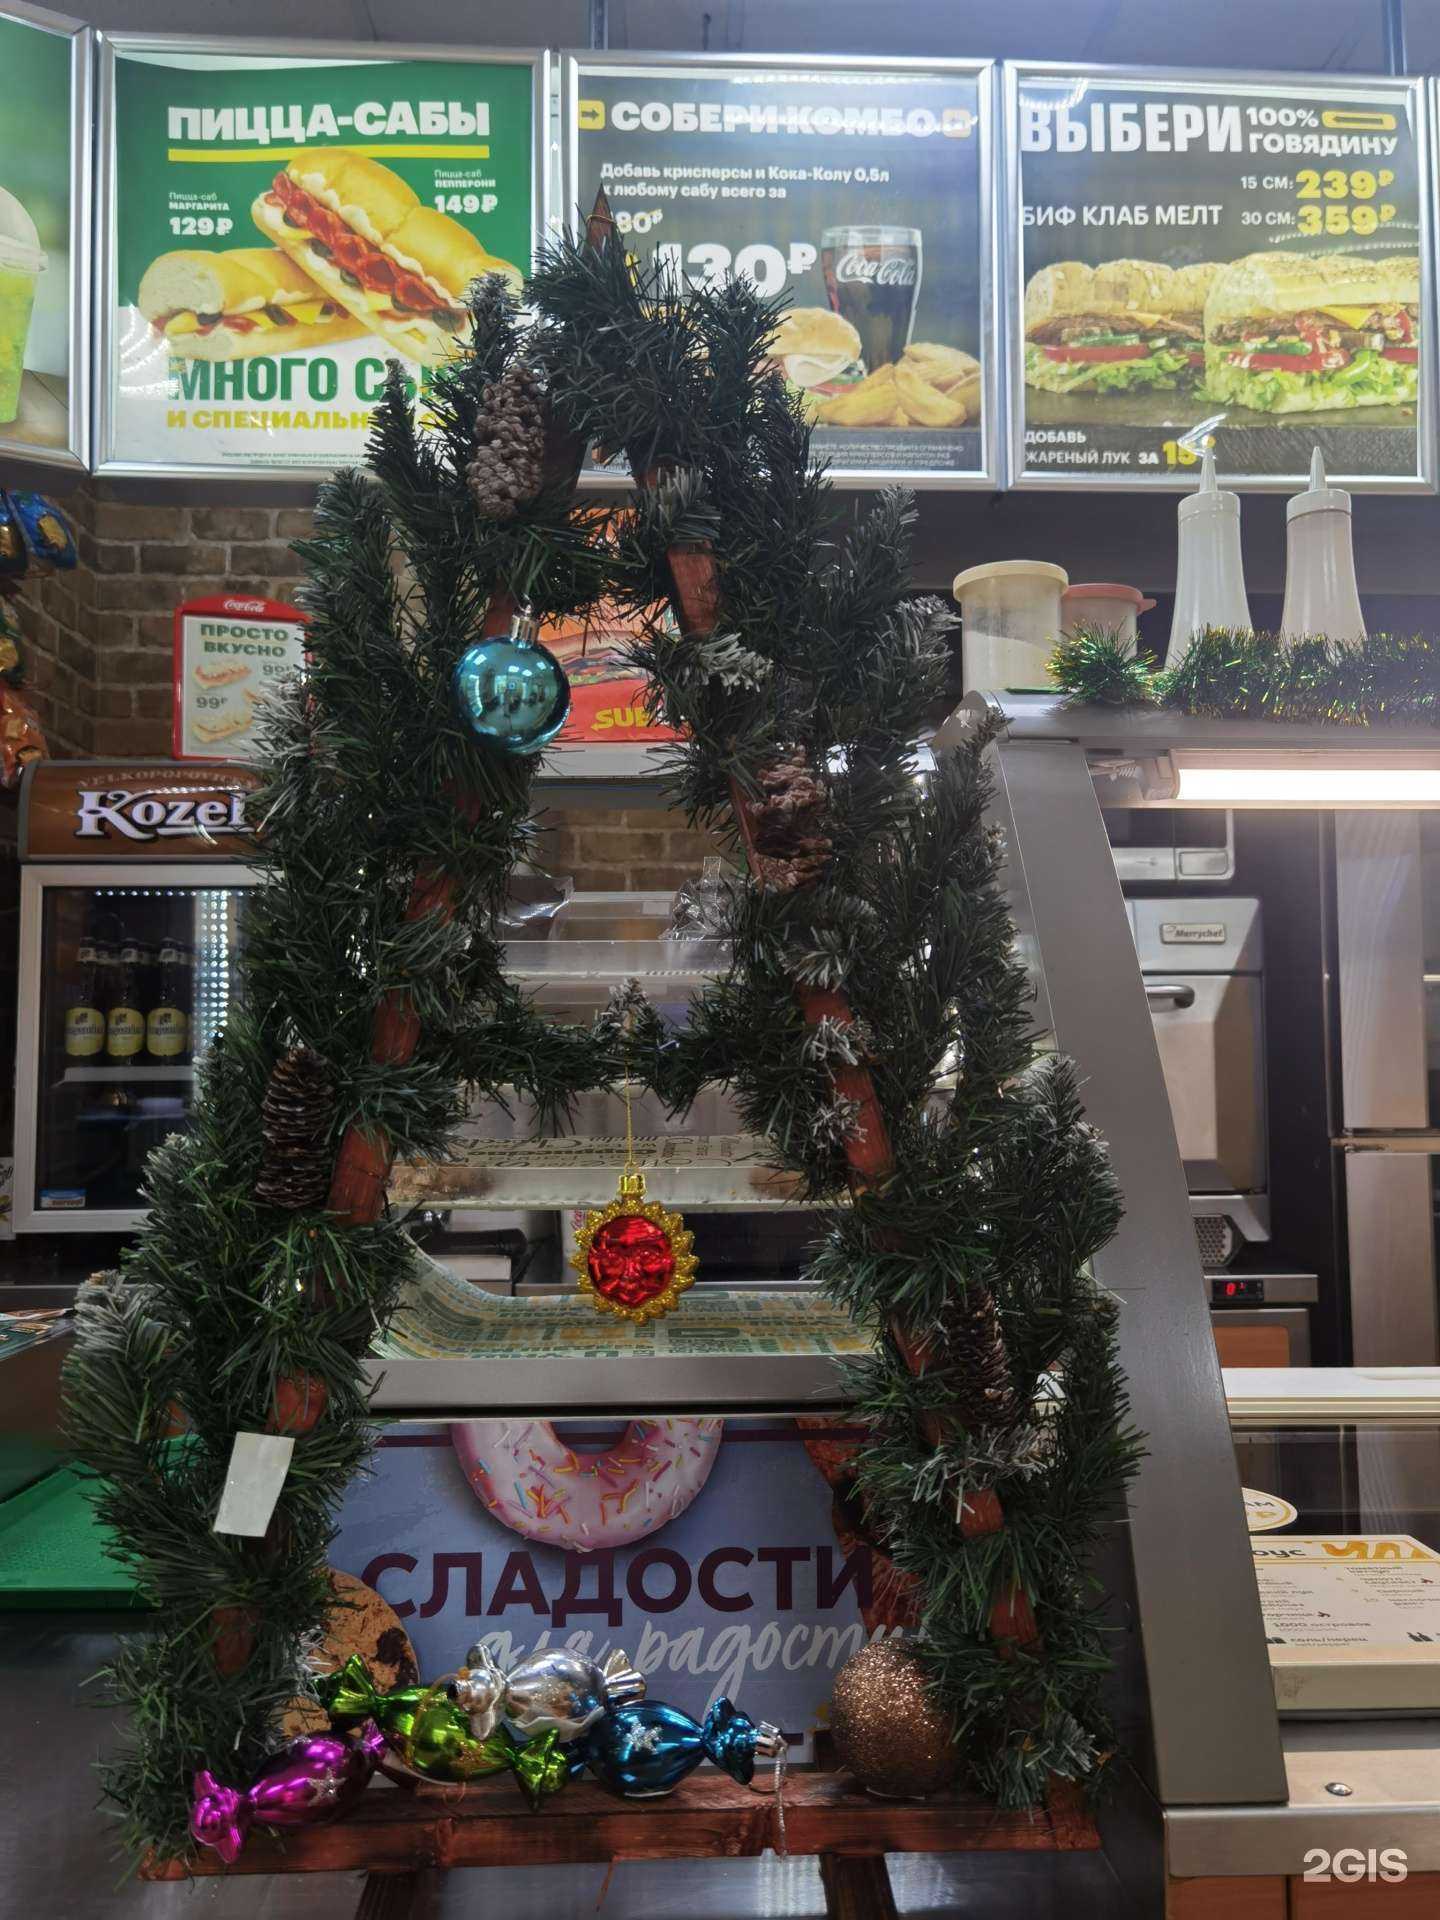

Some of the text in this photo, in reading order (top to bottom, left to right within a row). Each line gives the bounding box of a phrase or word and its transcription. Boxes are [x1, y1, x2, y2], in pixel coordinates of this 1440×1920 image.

[168, 101, 490, 144] ПИЦЦА-САБЫ
[611, 101, 936, 137] СОБЕРИ КОМБО
[1246, 107, 1319, 127] 100%
[1020, 103, 1242, 153] ВЫБЕРИ
[1249, 133, 1397, 157] ГОВЯДИНУ
[434, 169, 482, 179] Пицца-саб
[435, 179, 496, 188] ПЕППЕРОНИ
[601, 163, 660, 178] Добавь
[663, 168, 751, 182] крисперсы
[755, 170, 765, 180] и
[768, 167, 851, 184] Кока-Колу
[1240, 176, 1257, 190] 15
[614, 185, 678, 199] любому
[681, 184, 718, 200] сабу
[721, 187, 765, 198] всего
[768, 188, 786, 199] за
[169, 202, 229, 211] МАРГАРИТА
[1023, 205, 1223, 225] БИФ КЛАБ МЕЛТ
[1241, 212, 1262, 225] 30
[168, 356, 338, 402] МНОГО
[167, 409, 374, 430] И СПЕЦИАЛЬН
[1024, 430, 1086, 444] ДОБАВЬ
[1024, 449, 1098, 464] ЖАРЕНЫЙ
[1101, 452, 1130, 464] ЛУК
[1138, 452, 1159, 465] ЗА
[200, 623, 289, 641] ПРОСТО
[203, 641, 286, 657] ВКУСНО
[76, 790, 248, 840] Kozel
[362, 1547, 872, 1627] СЛАДОСТИ
